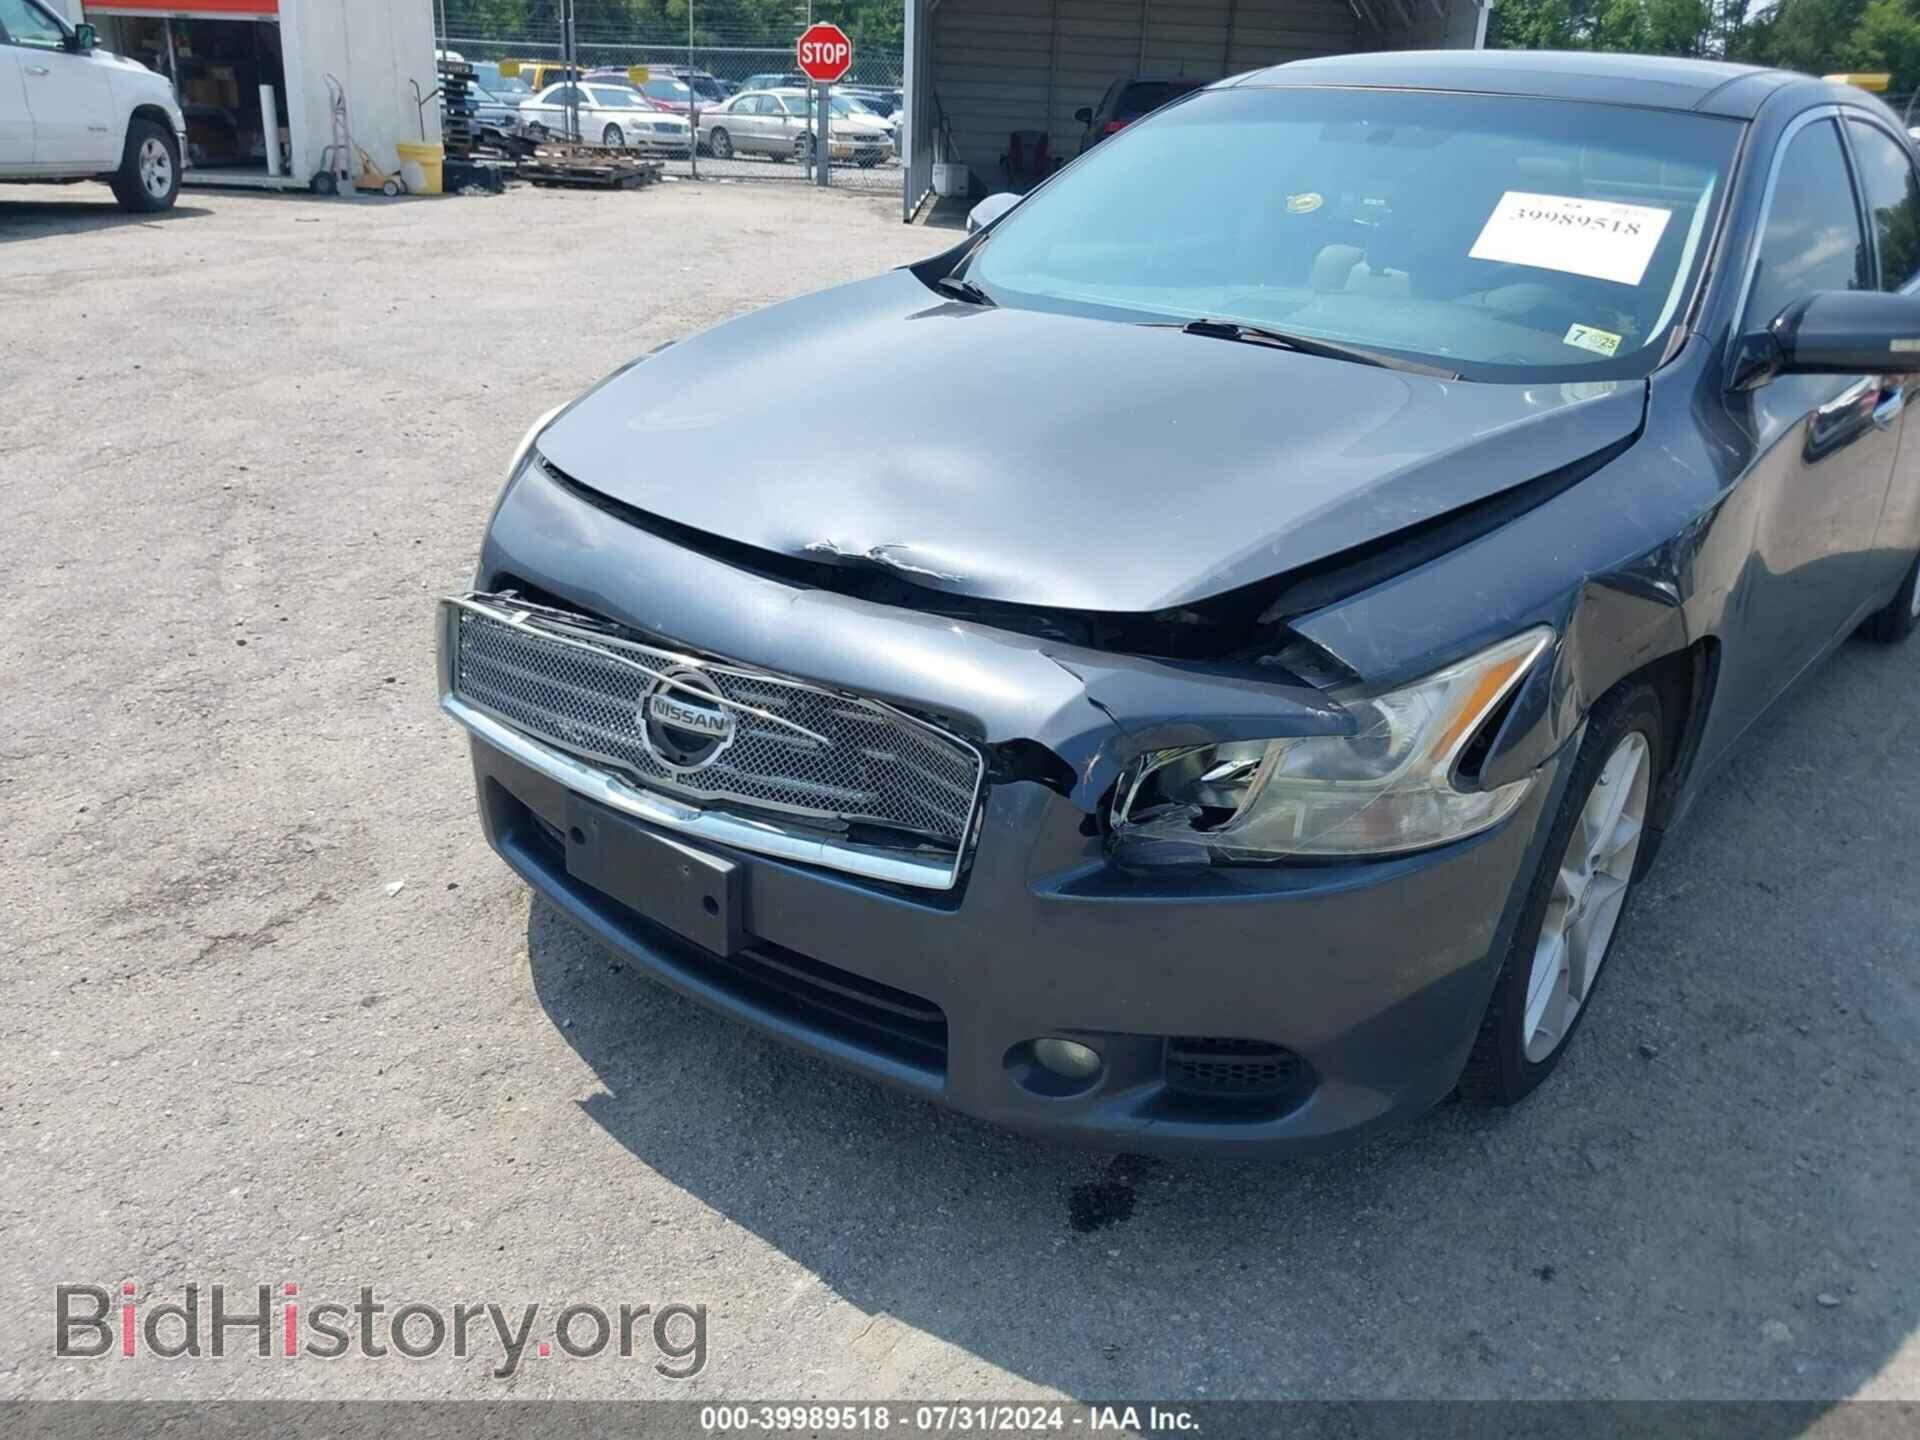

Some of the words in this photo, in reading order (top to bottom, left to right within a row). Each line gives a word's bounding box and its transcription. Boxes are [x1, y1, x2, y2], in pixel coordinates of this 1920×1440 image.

[802, 42, 847, 64] STOP
[1509, 208, 1642, 236] 39989518
[1573, 329, 1587, 342] 7
[653, 700, 726, 730] NISSAN
